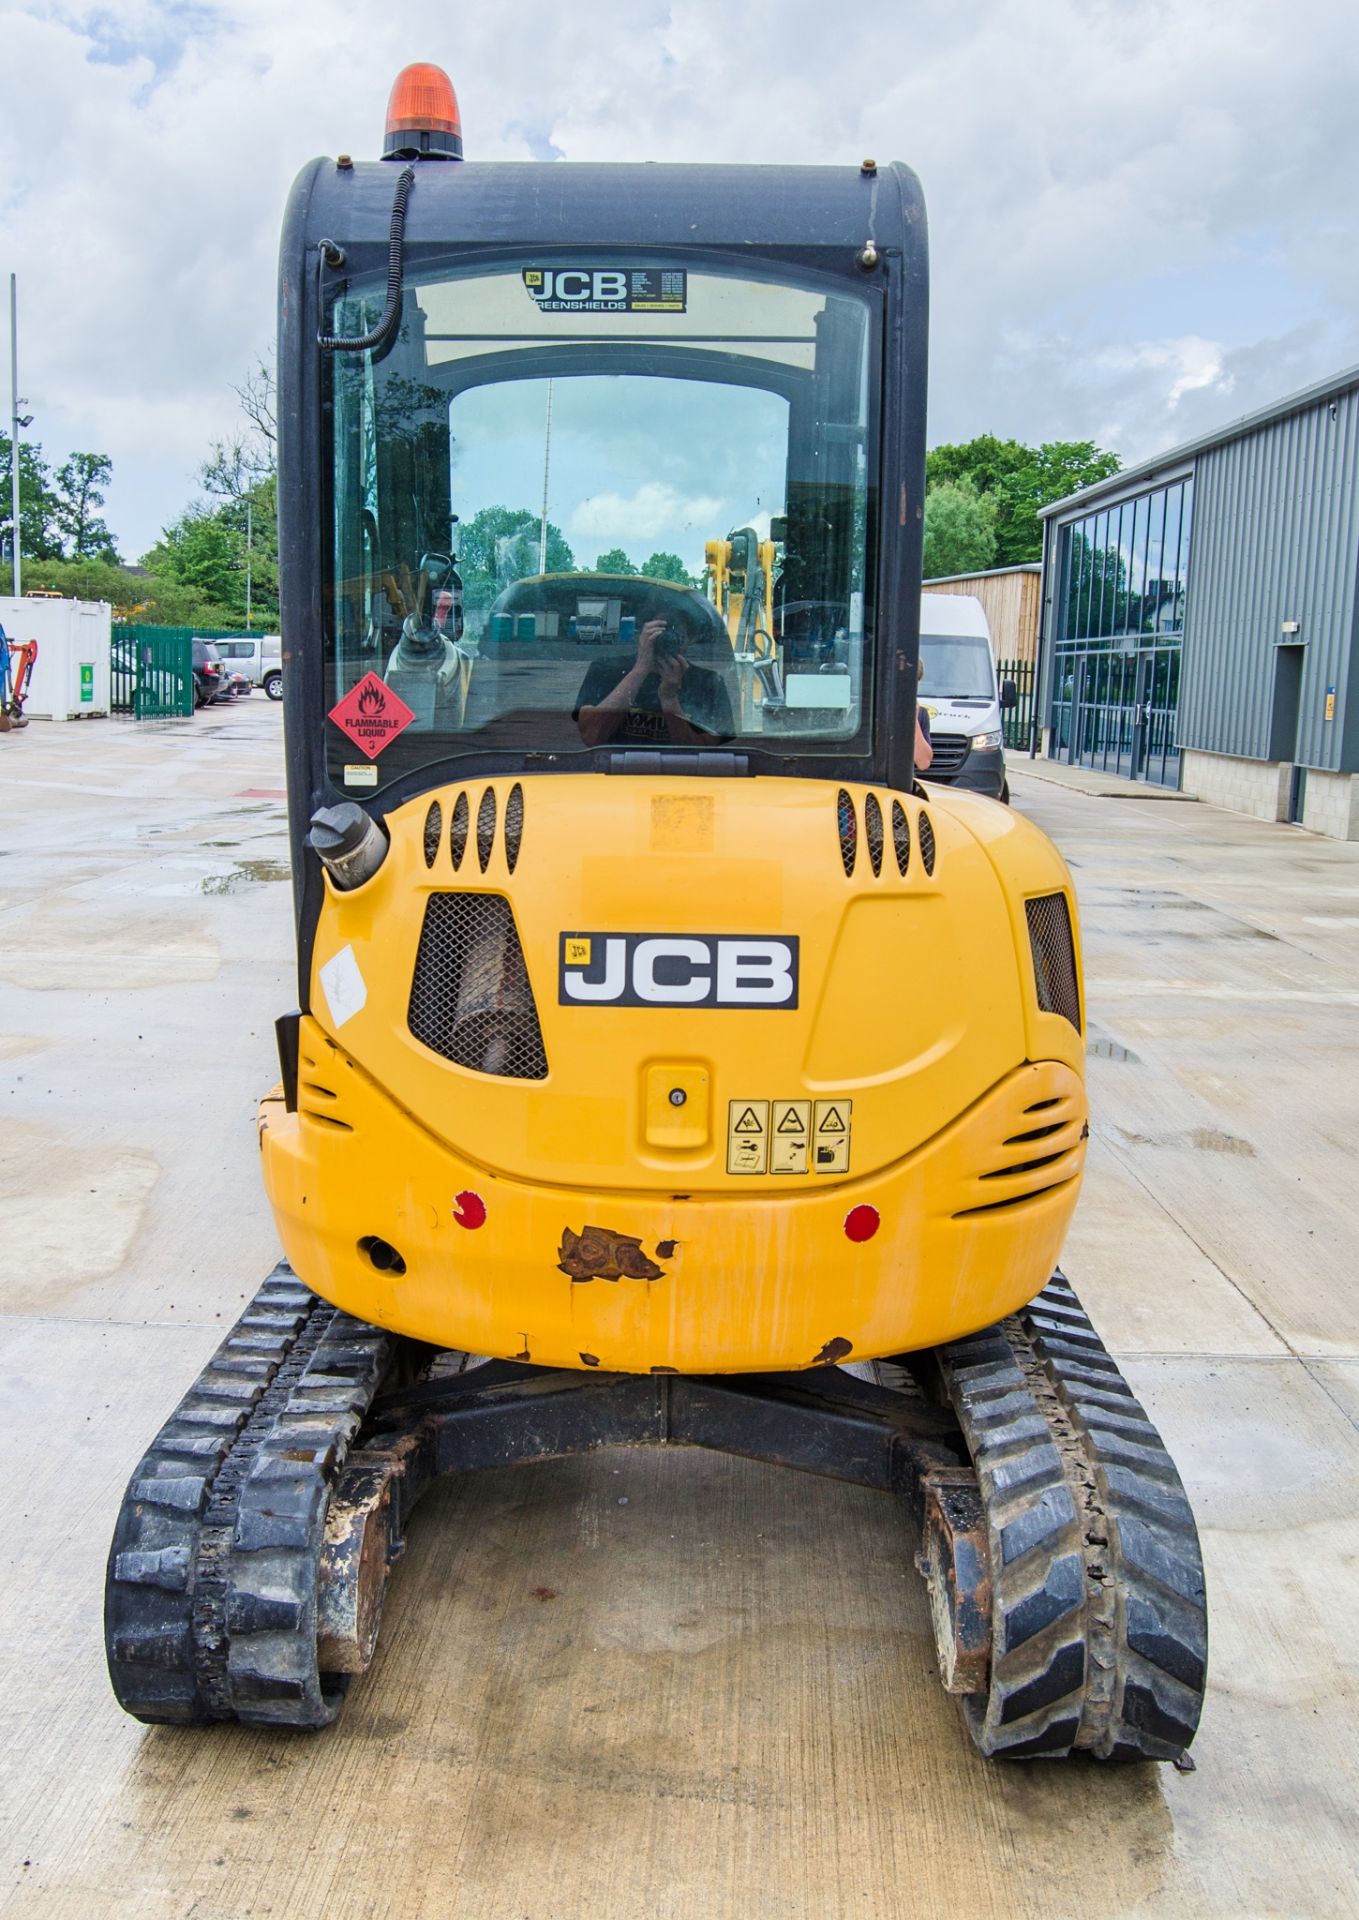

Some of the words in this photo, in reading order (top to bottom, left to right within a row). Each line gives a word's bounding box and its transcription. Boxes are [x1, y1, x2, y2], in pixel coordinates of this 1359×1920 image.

[527, 271, 628, 300] JCB
[536, 301, 627, 310] REENSHIELDS
[345, 718, 399, 728] FLAMMABLE
[358, 728, 386, 738] LIQUID
[368, 740, 376, 750] 3
[571, 945, 587, 958] JCB
[564, 938, 794, 1004] JCB
